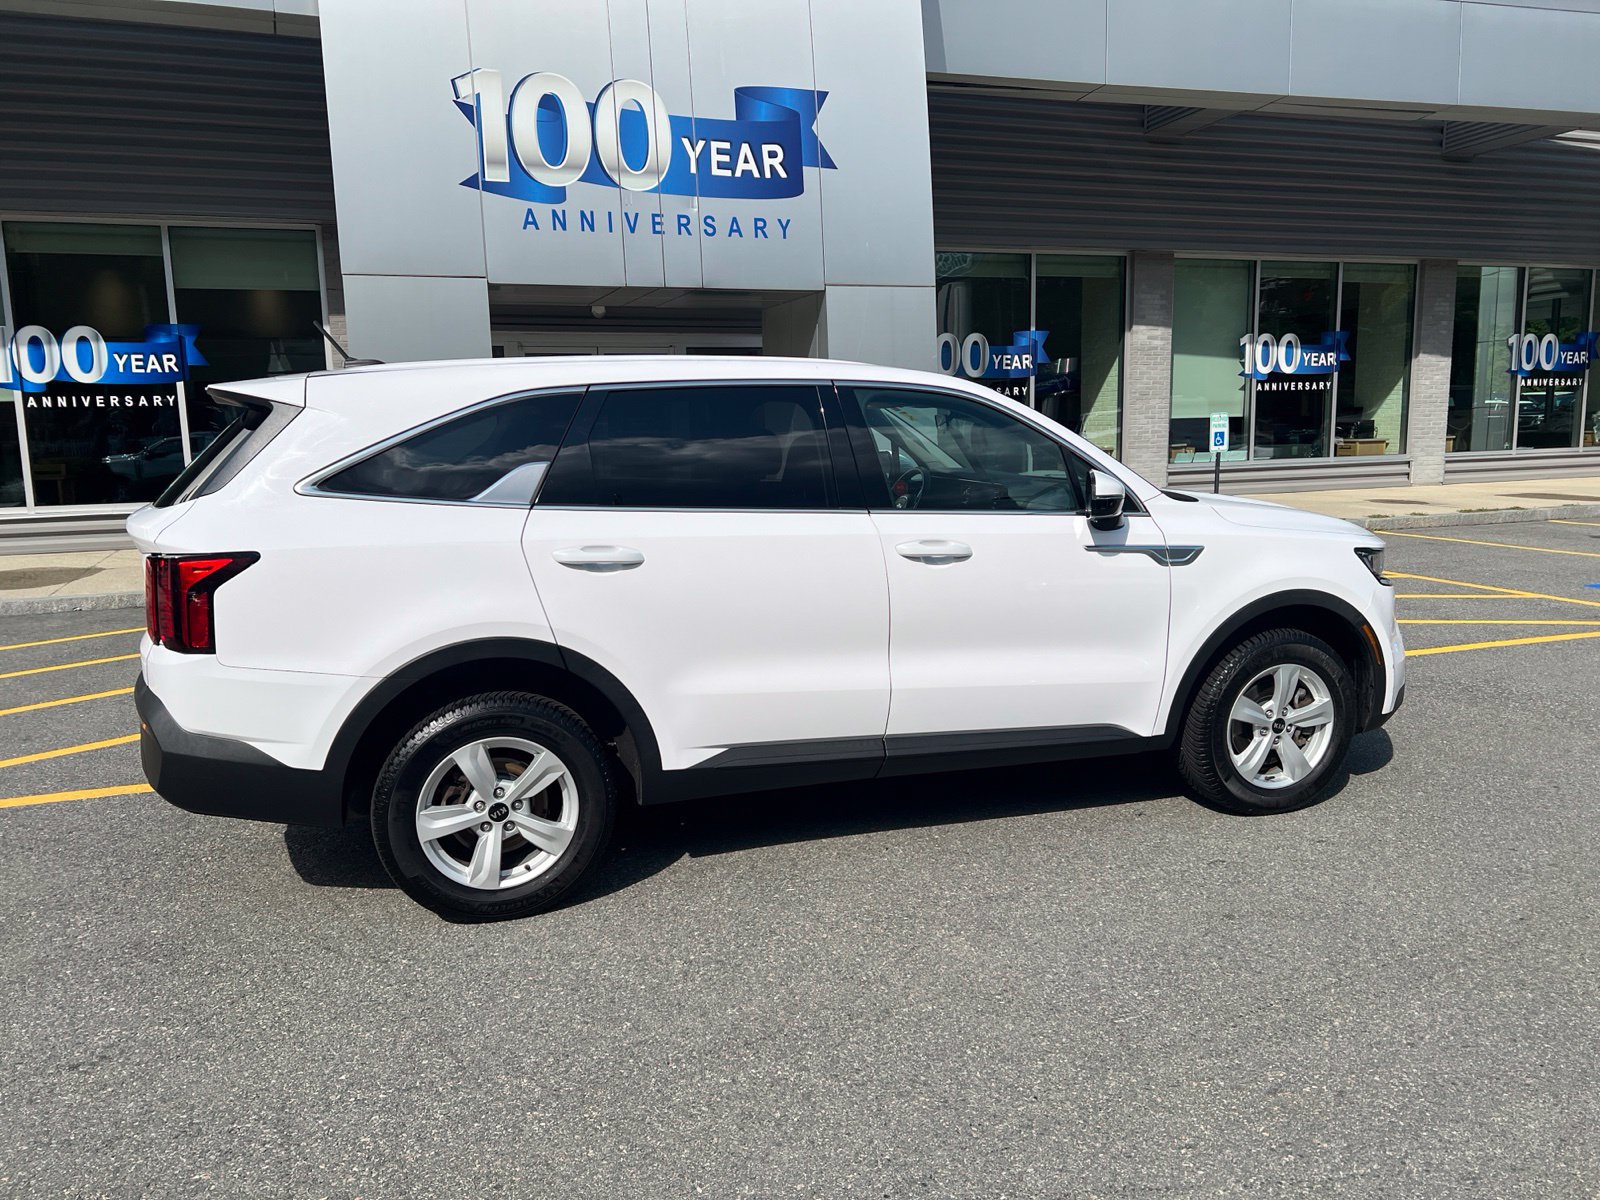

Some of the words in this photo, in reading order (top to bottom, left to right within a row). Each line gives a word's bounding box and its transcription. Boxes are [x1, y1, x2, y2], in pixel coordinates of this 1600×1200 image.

[450, 67, 672, 192] 100
[681, 136, 789, 180] YEAR
[522, 207, 792, 240] ANNIVERSARY
[992, 353, 1034, 370] YEAR
[1239, 332, 1302, 375] 100
[1302, 352, 1337, 367] YEAR
[1507, 333, 1559, 371] 100
[1560, 351, 1589, 364] YEAR
[112, 353, 180, 374] YEAR
[1256, 381, 1333, 391] ANNIVERSARY
[1520, 378, 1583, 387] ANNIVERSARY
[26, 395, 178, 408] ANNIVERSARY
[490, 806, 508, 819] KIA
